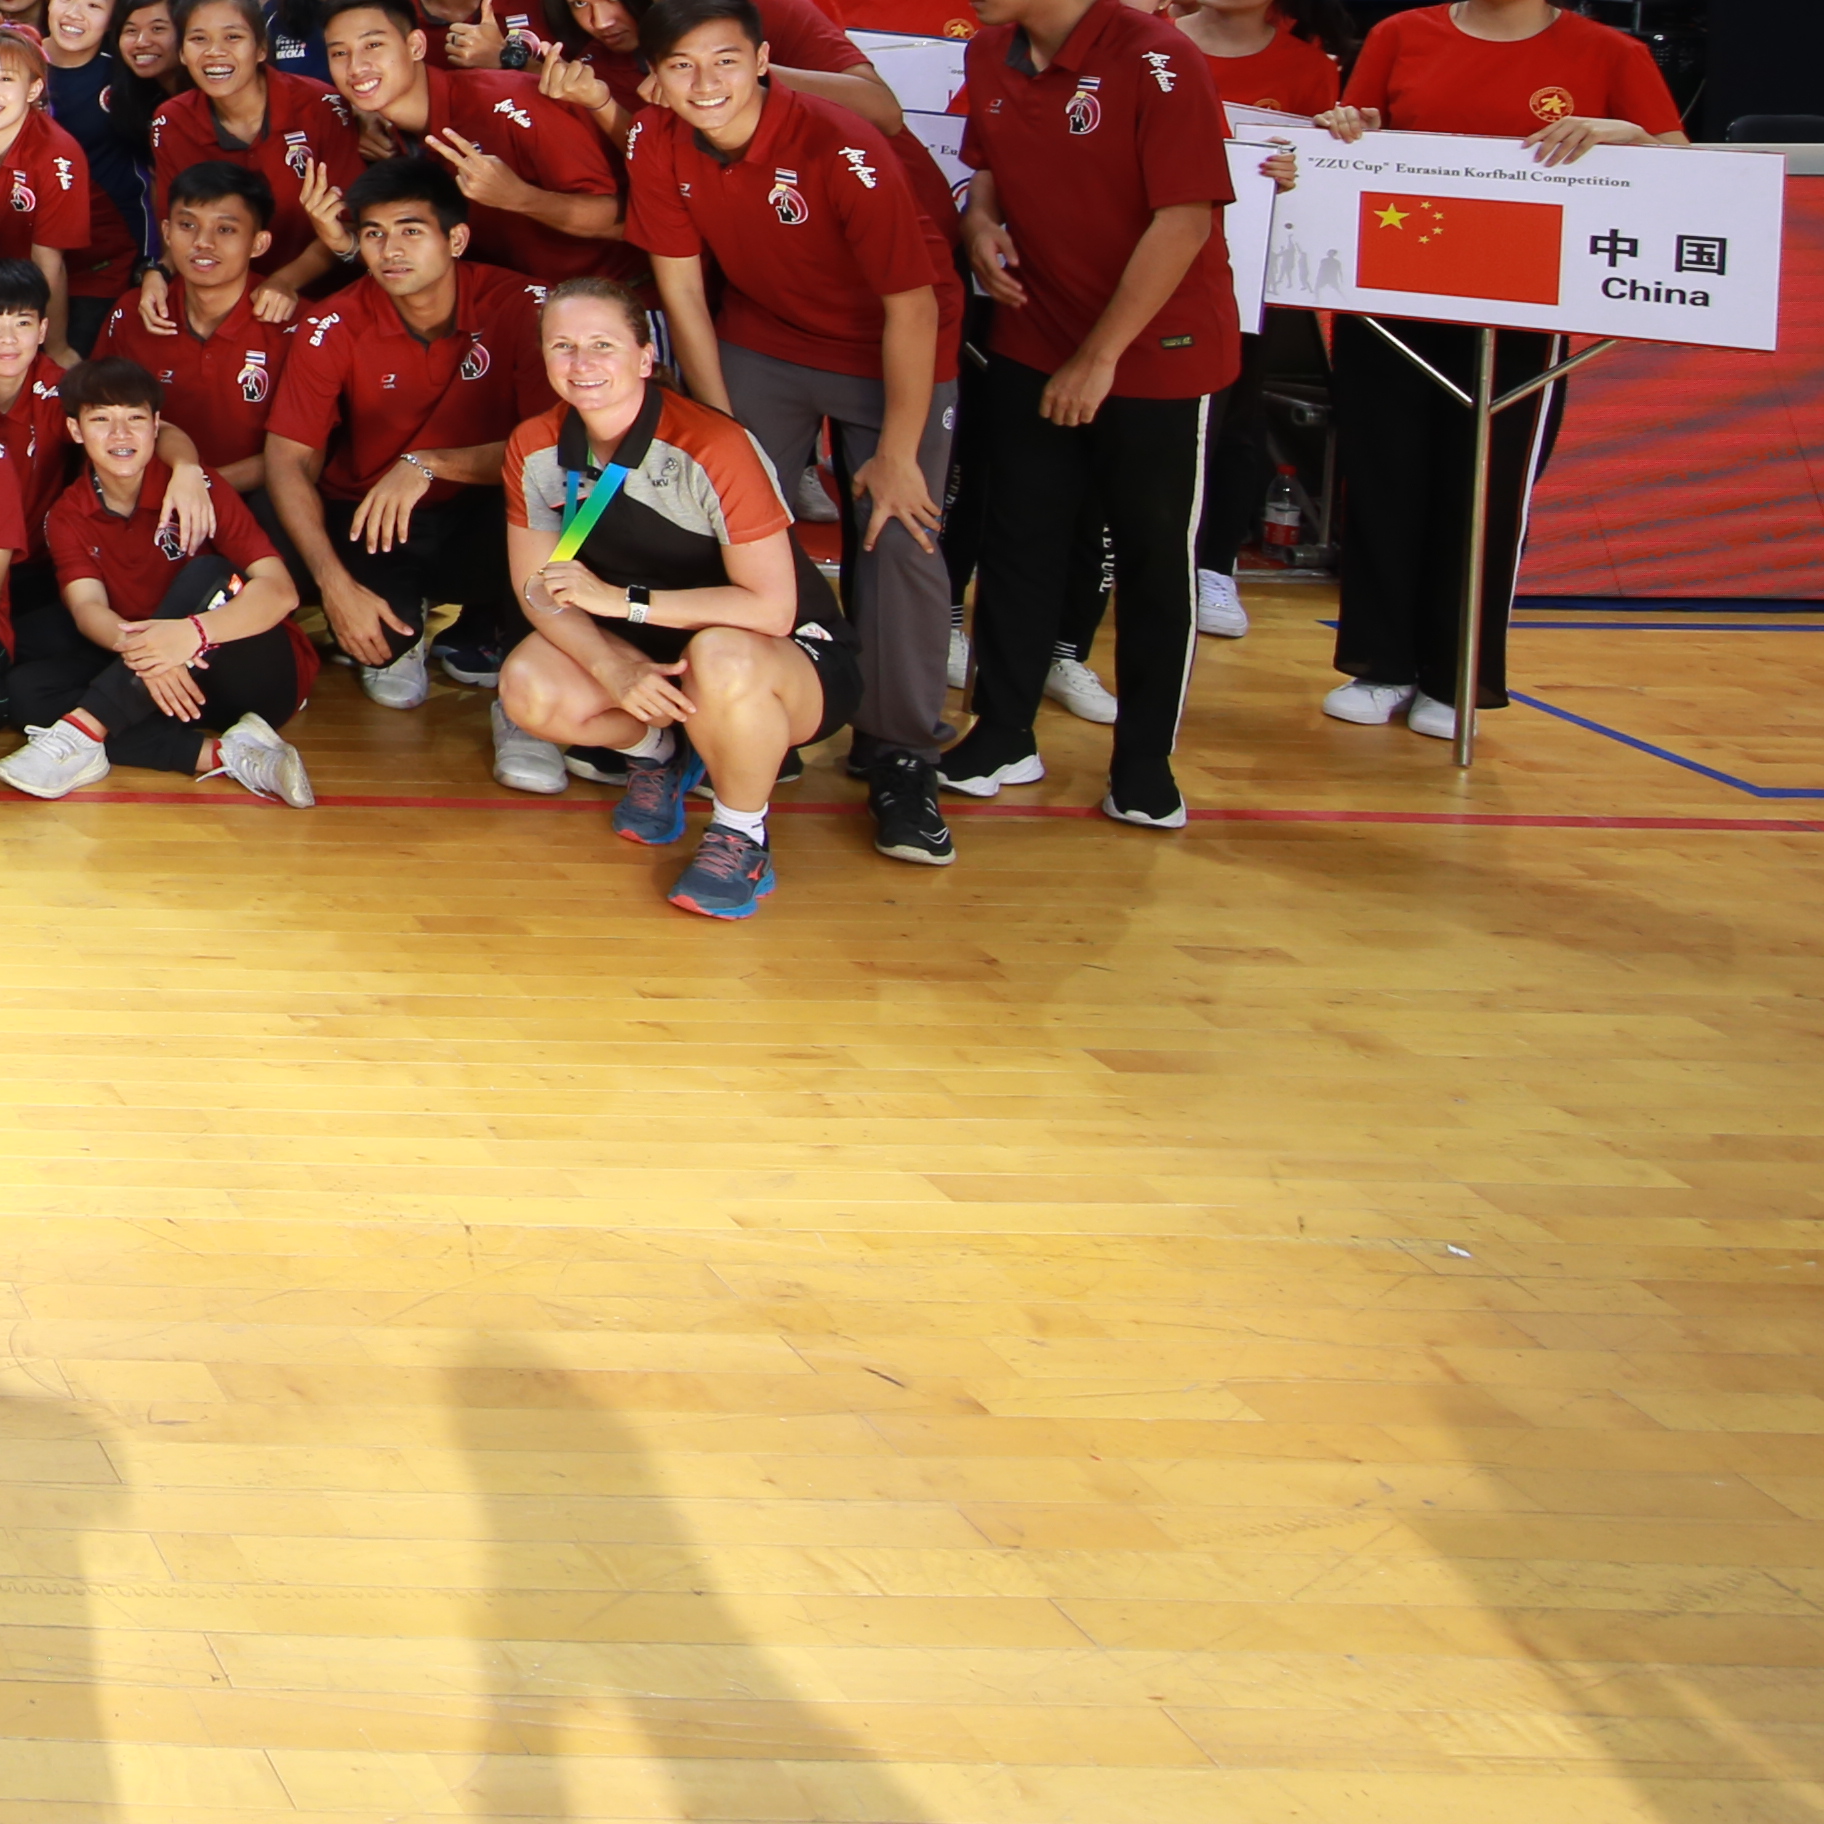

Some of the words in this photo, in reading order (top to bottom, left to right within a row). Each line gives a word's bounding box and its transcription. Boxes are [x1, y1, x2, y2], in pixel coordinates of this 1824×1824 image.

[1396, 163, 1461, 178] Eurasian
[1464, 167, 1527, 181] Korfball
[1530, 170, 1631, 189] Competition
[1589, 228, 1728, 277] 中国
[1601, 276, 1711, 308] China
